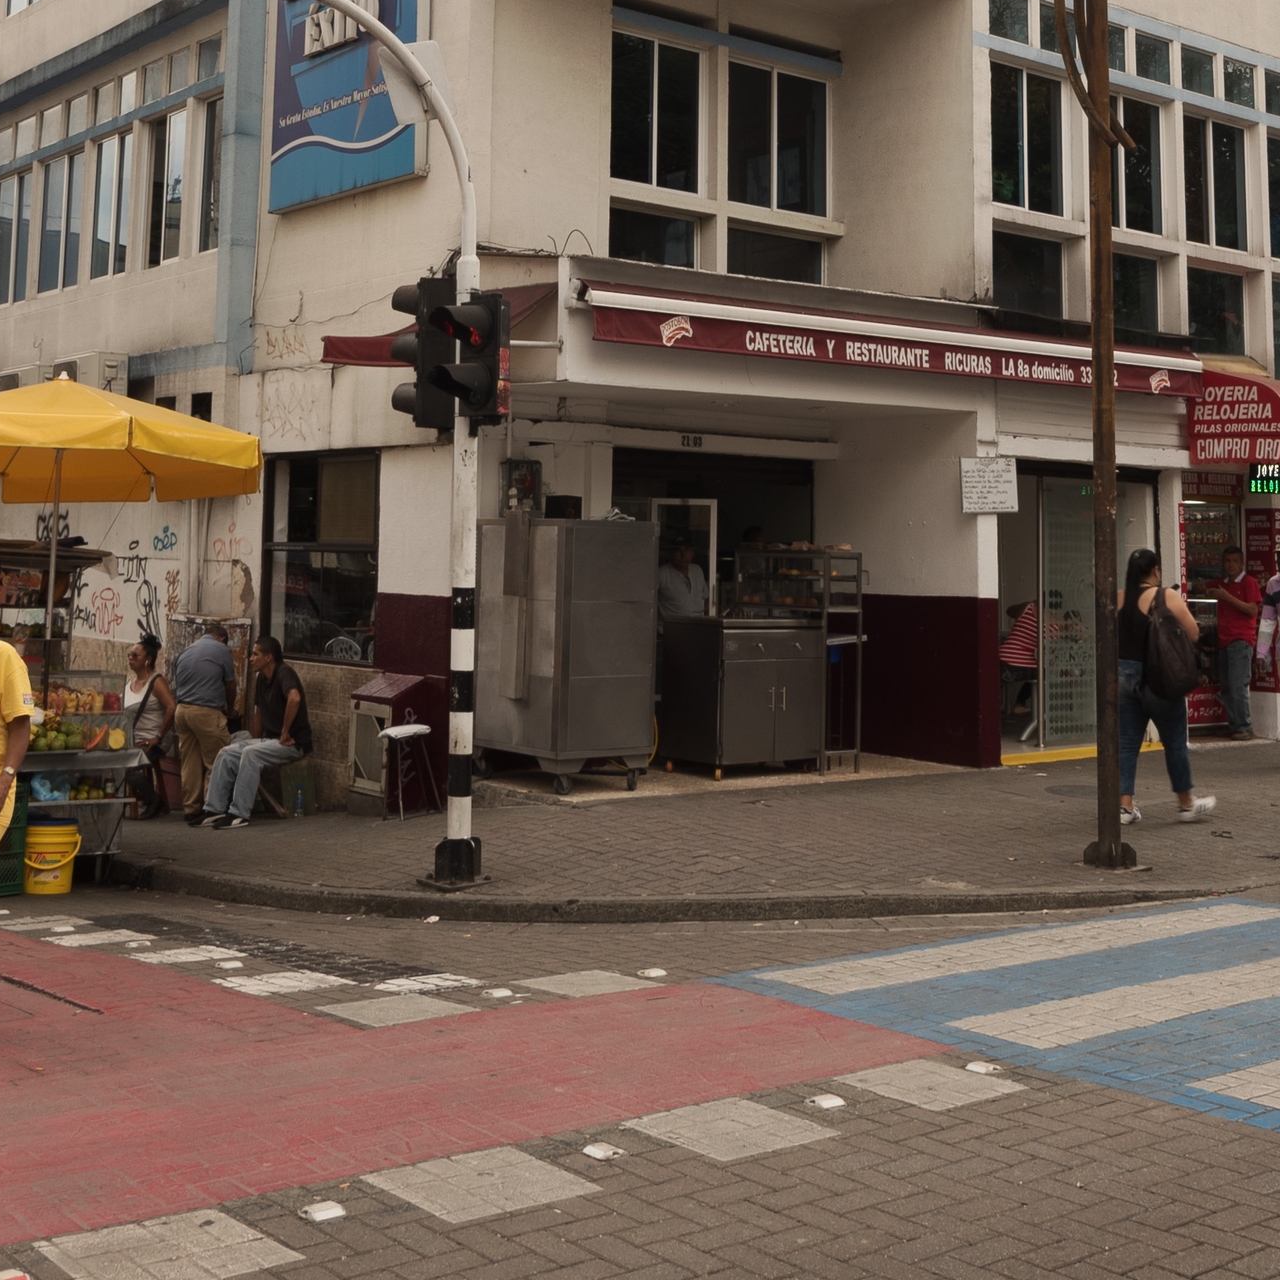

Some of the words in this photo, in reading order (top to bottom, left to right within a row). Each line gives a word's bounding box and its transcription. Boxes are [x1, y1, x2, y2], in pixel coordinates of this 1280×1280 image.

[331, 95, 352, 110] Nuestra
[352, 89, 371, 104] Mayor
[745, 330, 816, 356] CAFETERIA
[826, 339, 836, 359] Y
[846, 341, 930, 369] RESTAURANTE
[944, 351, 992, 375] RICURAS
[1001, 357, 1015, 377] LA
[1031, 361, 1074, 383] domicilio
[1195, 385, 1258, 402] OYERIA
[1194, 403, 1272, 420] RELOJERIA
[1194, 424, 1222, 433] PILAS
[1197, 438, 1250, 460] COMPRO
